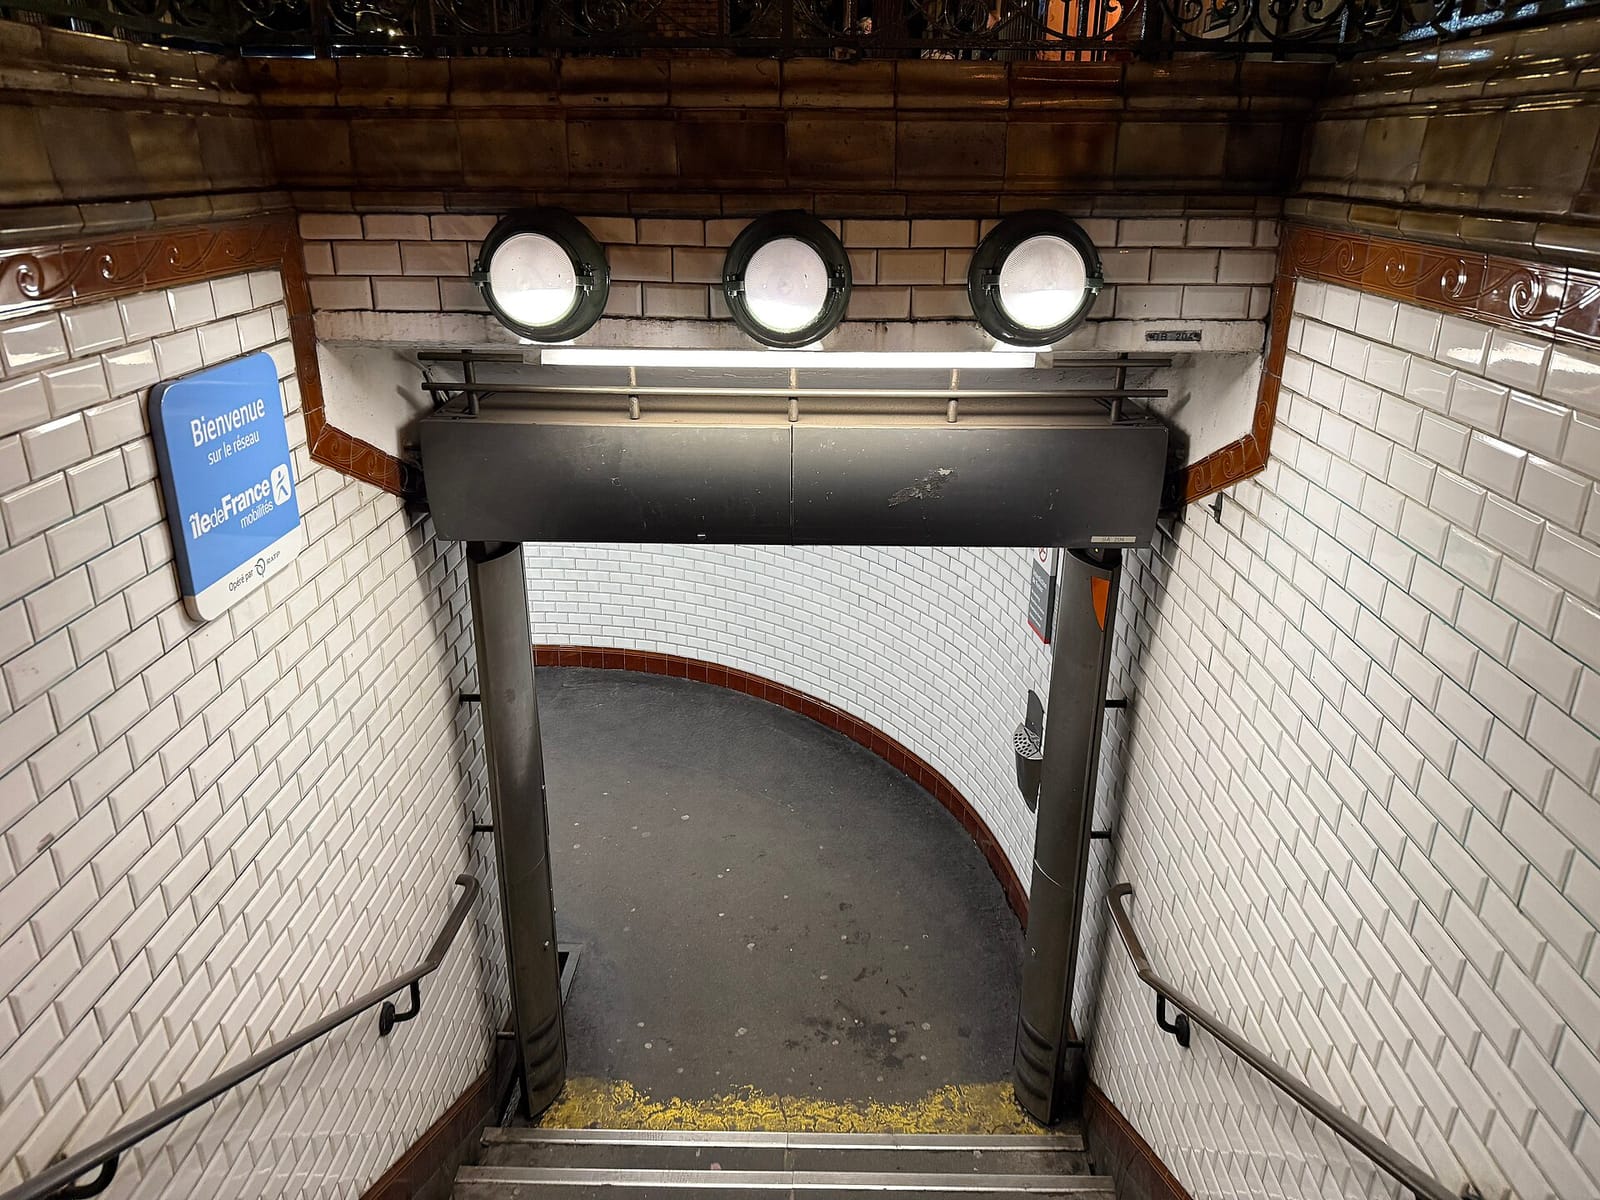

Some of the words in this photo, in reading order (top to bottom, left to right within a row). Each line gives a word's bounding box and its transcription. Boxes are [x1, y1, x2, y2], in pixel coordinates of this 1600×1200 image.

[190, 398, 266, 448] Bienvenue
[207, 448, 222, 466] sur
[223, 441, 232, 458] le
[233, 430, 260, 453] réseau
[240, 499, 274, 529] mobilités
[228, 573, 245, 592] Opéré
